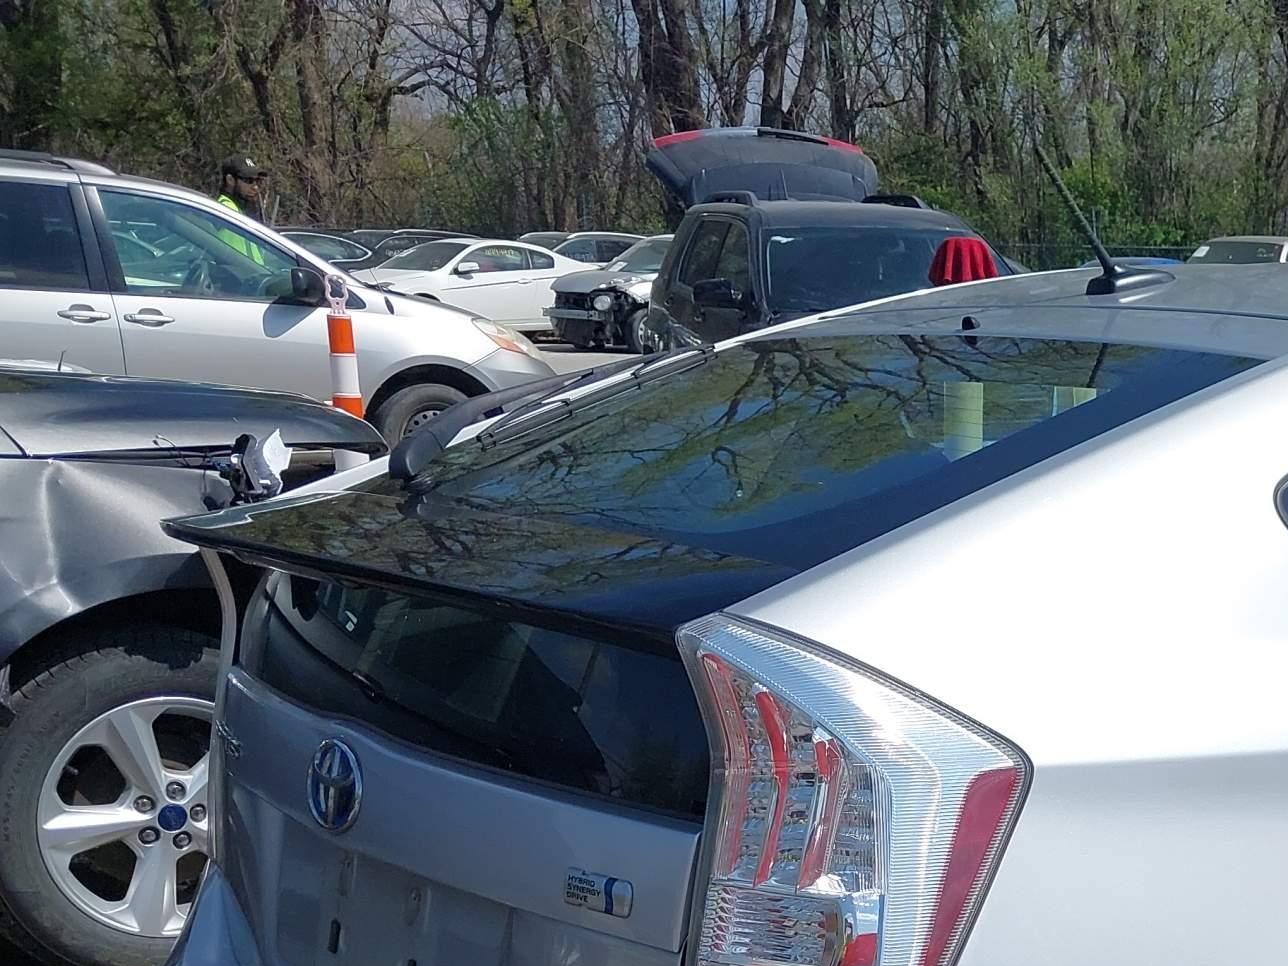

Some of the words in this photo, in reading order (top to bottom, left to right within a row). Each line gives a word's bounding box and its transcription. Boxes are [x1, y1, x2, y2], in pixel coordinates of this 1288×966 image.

[567, 873, 596, 888] HYBRID
[566, 890, 588, 903] DRIVE
[567, 882, 601, 897] SYNERGY
